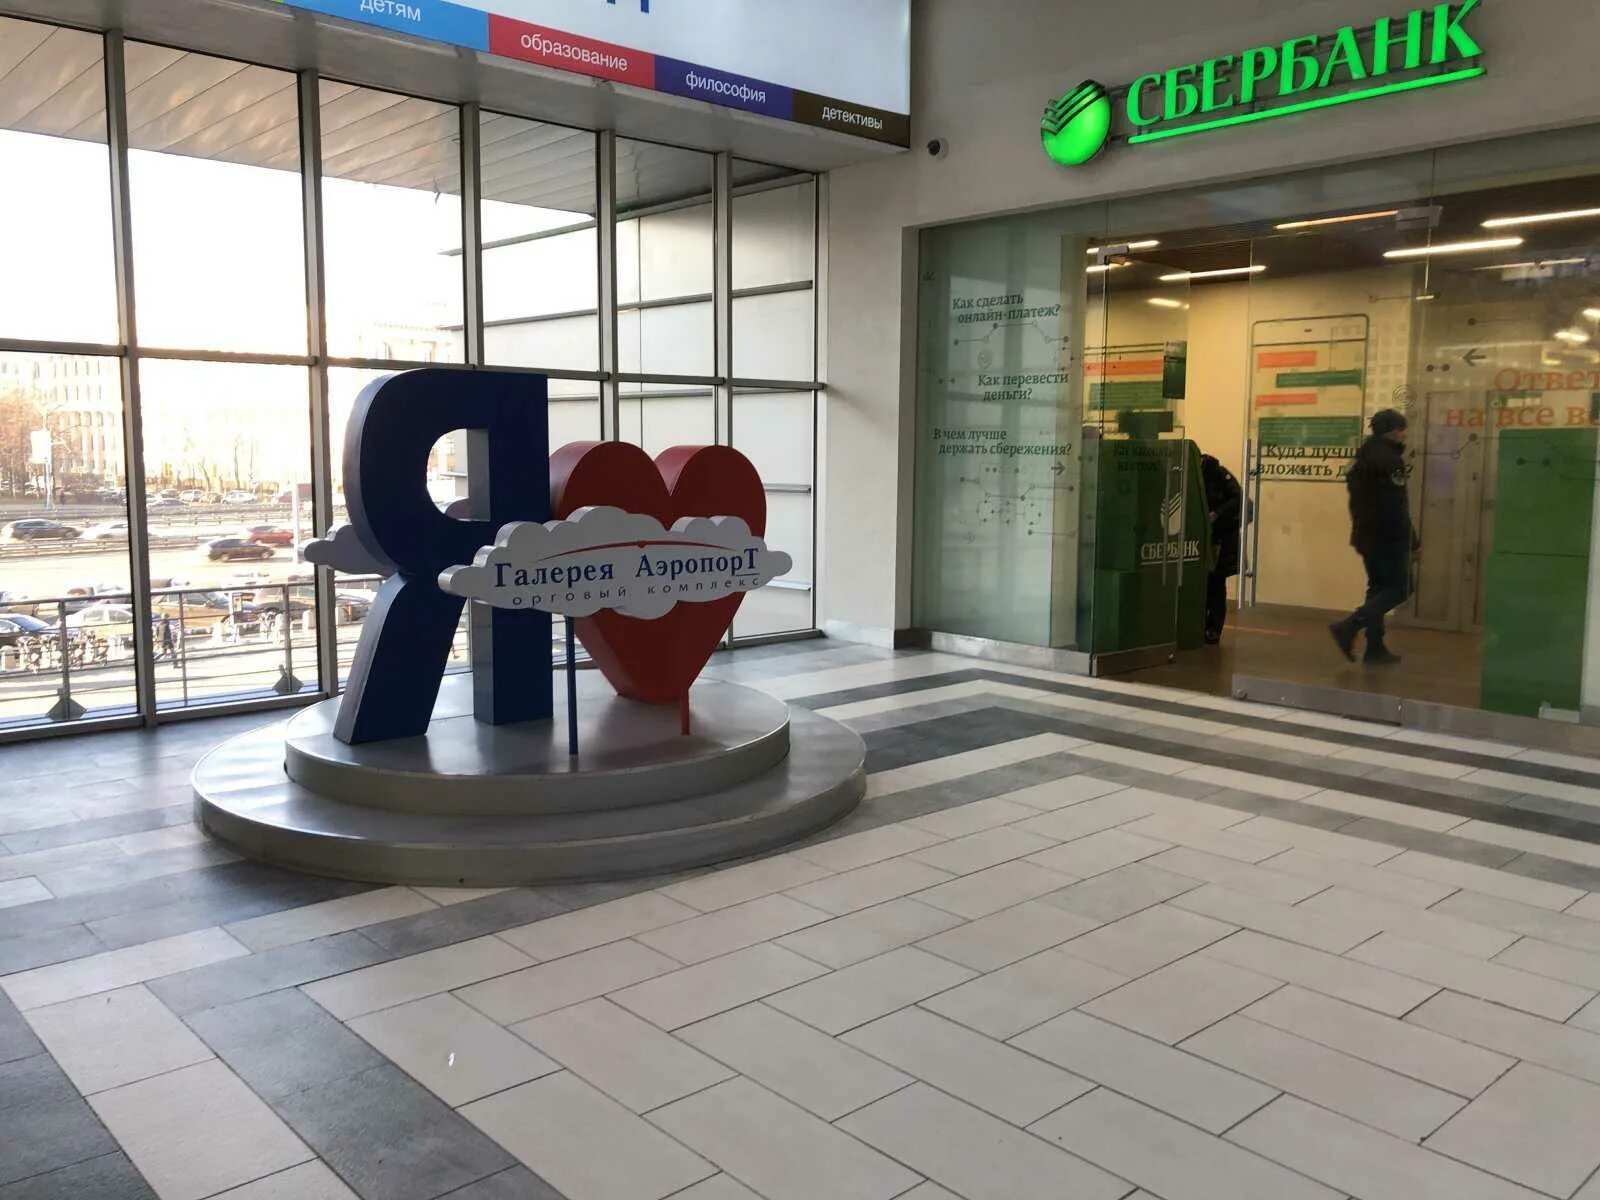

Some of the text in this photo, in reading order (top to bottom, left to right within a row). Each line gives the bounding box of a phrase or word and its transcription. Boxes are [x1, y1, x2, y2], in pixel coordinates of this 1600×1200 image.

[360, 0, 421, 22] детям
[520, 32, 628, 72] образование
[1126, 0, 1482, 127] СБЕРБАНК
[685, 70, 767, 105] философия
[822, 103, 884, 131] детективы
[952, 292, 1024, 310] Как сделать
[957, 303, 1061, 324] онлайн-платеж?
[978, 372, 1069, 388] Как перевести
[983, 388, 1033, 402] деньги?
[1446, 407, 1484, 428] на
[1496, 406, 1554, 428] все
[944, 430, 966, 440] чем
[968, 429, 1007, 442] лучше
[938, 442, 1072, 457] держать сбережения?
[1266, 444, 1306, 461] Куда
[494, 562, 615, 589] Галерея
[647, 576, 762, 596] комплекс
